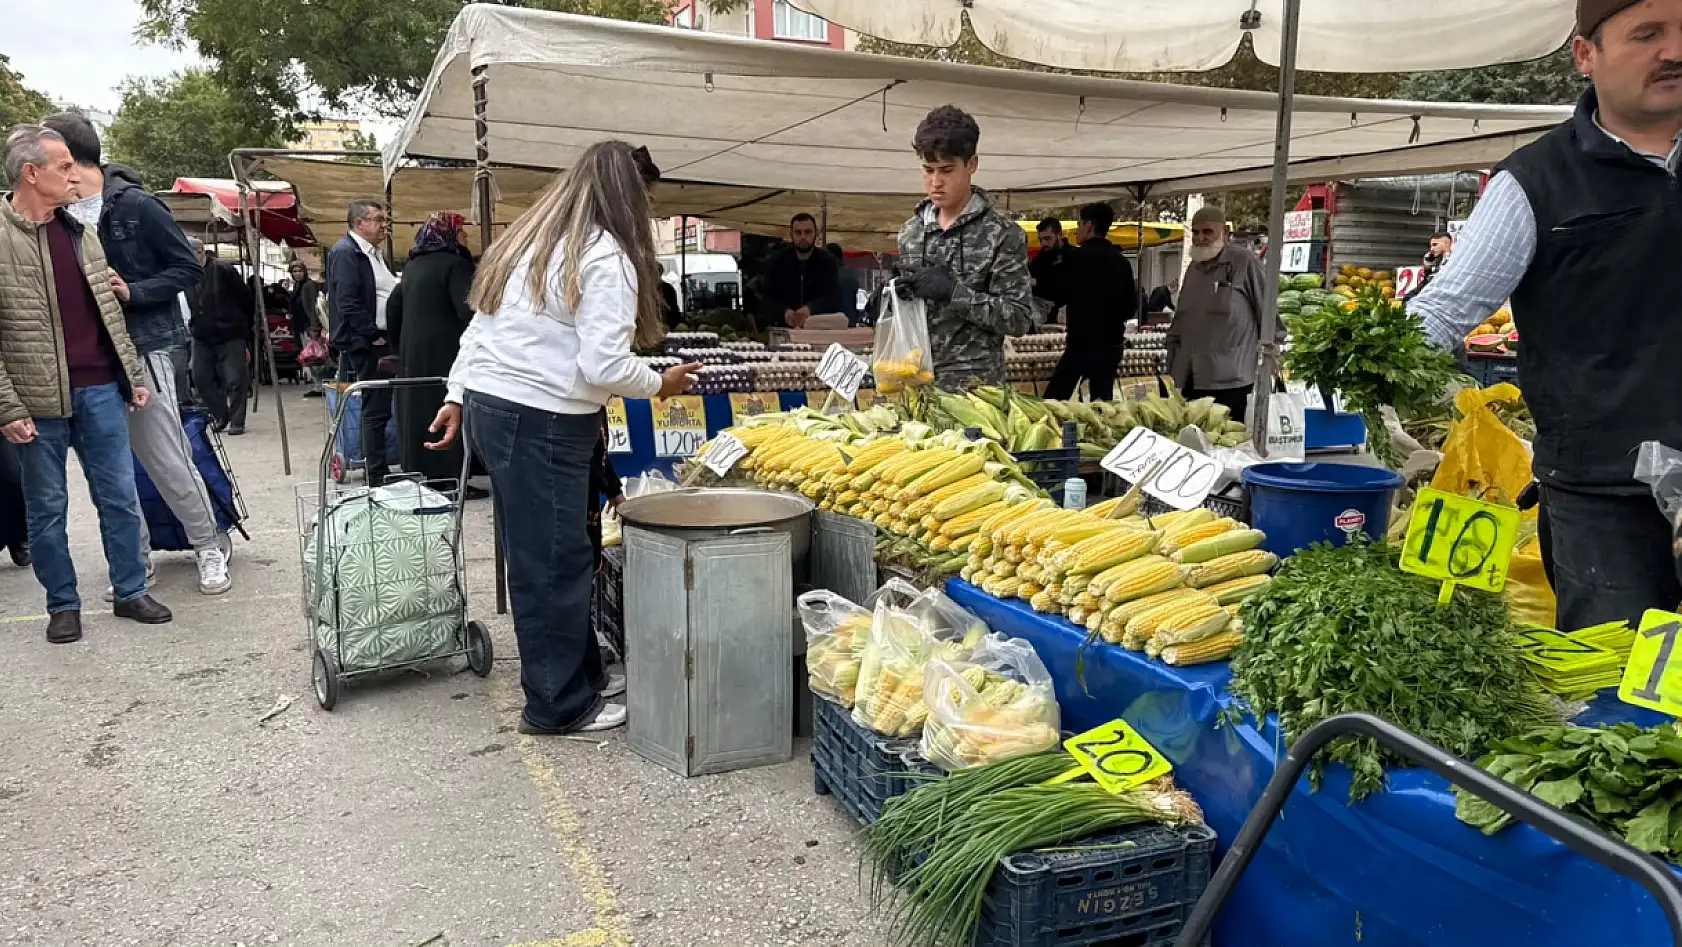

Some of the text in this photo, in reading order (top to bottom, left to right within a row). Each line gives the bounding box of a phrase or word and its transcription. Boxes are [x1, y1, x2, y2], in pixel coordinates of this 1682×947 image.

[1105, 429, 1157, 471] 12
[1142, 446, 1215, 498] 100
[1418, 498, 1498, 577] 10
[1075, 729, 1152, 776] 20
